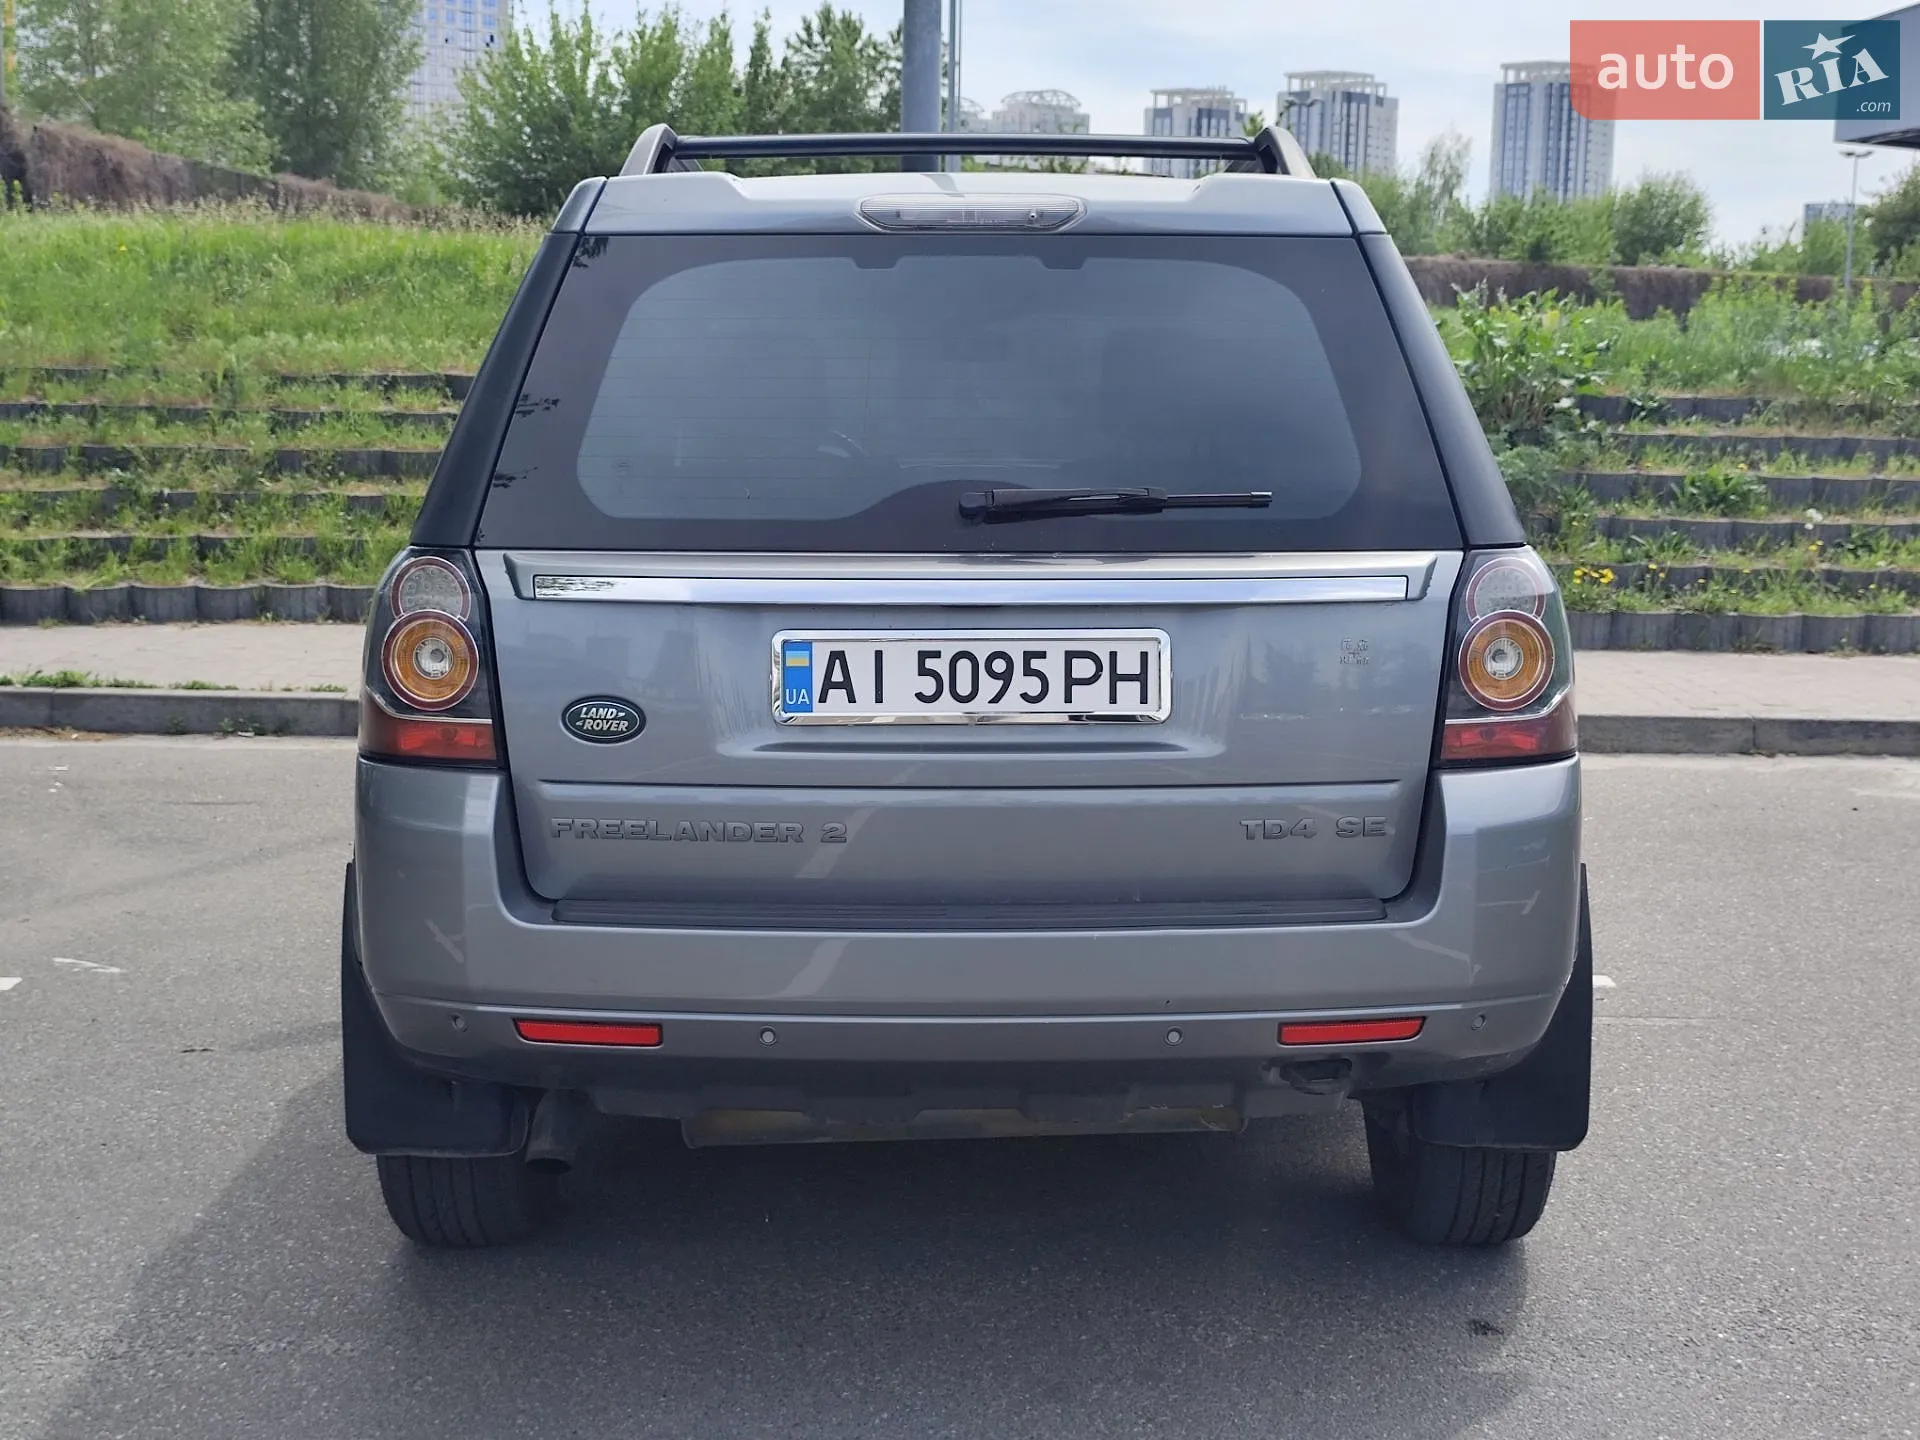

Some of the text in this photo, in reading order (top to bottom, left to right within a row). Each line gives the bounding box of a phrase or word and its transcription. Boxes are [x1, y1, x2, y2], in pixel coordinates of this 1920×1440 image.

[818, 649, 1150, 705] AI 5095 PH
[785, 688, 810, 705] UA
[580, 706, 617, 720] LAND
[582, 718, 629, 732] ROVER
[551, 817, 848, 844] FREELANDER 2
[1239, 815, 1388, 840] TD4 SE
